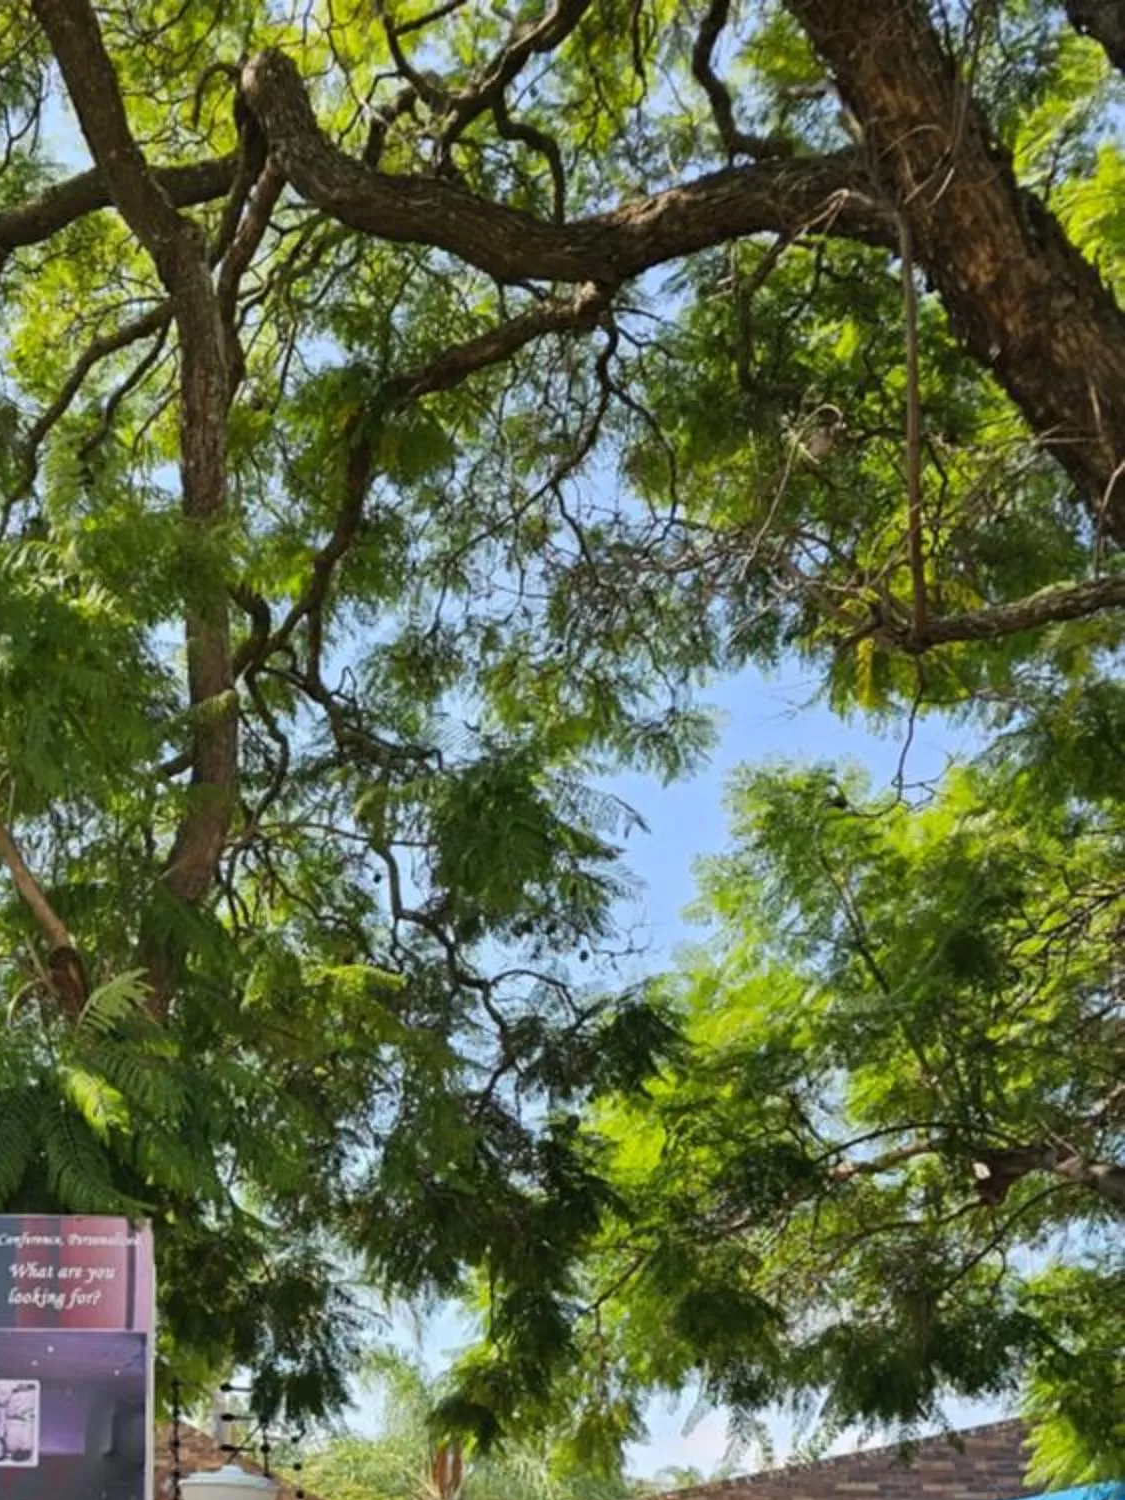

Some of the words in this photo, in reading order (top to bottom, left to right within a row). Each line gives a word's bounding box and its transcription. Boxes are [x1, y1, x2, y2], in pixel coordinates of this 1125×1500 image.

[9, 1261, 53, 1279] What
[57, 1267, 82, 1279] are
[85, 1266, 116, 1284] you
[8, 1288, 65, 1310] looking
[65, 1288, 102, 1310] for?
